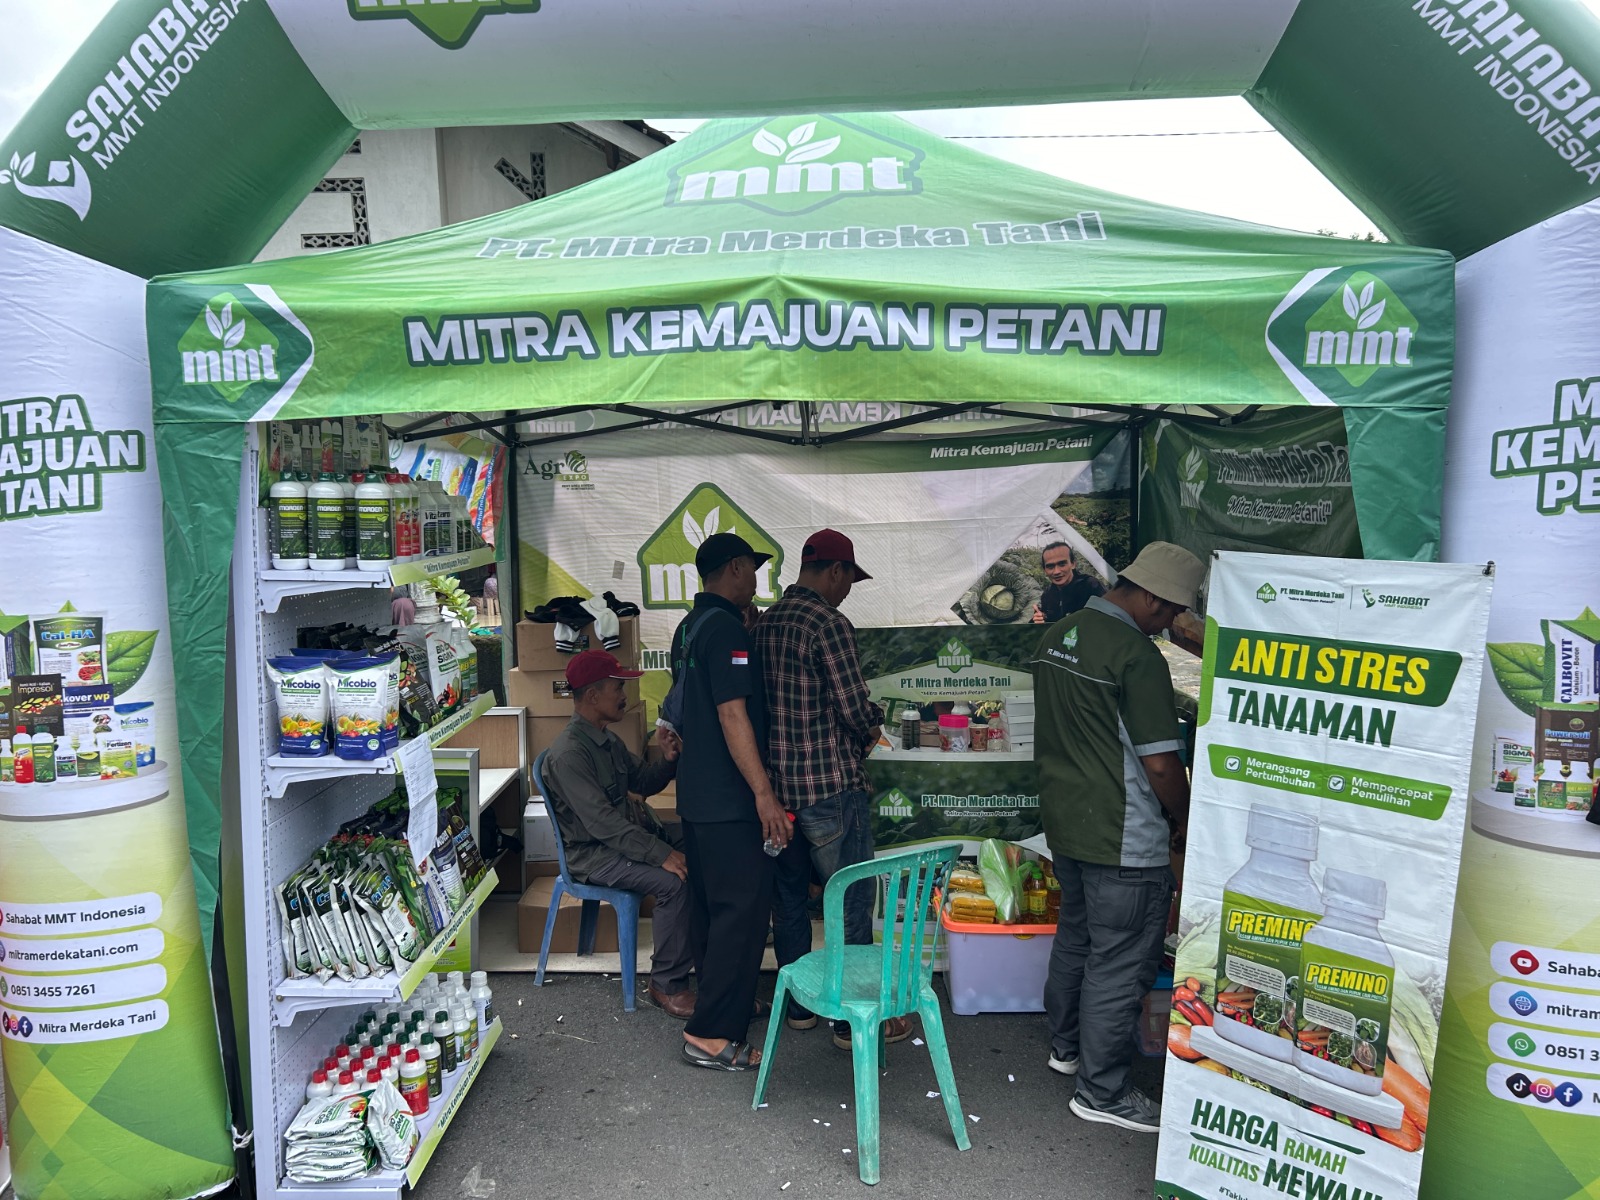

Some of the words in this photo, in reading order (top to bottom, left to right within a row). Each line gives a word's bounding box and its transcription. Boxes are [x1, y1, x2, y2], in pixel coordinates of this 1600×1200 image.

[1444, 0, 1600, 153] AHABA
[1411, 0, 1483, 55] MMT
[1473, 54, 1600, 185] INDONESIA
[91, 105, 145, 170] MMT
[680, 157, 906, 201] mmt
[476, 237, 555, 259] PT.
[561, 236, 710, 259] Mitra
[718, 225, 969, 254] Merdeka
[973, 211, 1108, 246] Tani
[405, 313, 598, 363] MITRA
[610, 303, 931, 353] KEMAJUAN
[948, 307, 1163, 351] PETANI
[1305, 327, 1413, 365] mmt
[183, 344, 279, 383] mmt
[0, 399, 86, 438] TRA
[930, 445, 968, 459] Mitra
[971, 441, 1044, 457] Kemajuan
[1046, 434, 1093, 451] Petani
[1495, 425, 1600, 471] KEM
[1249, 499, 1293, 524] Kemajuan
[650, 562, 774, 602] mt
[1289, 588, 1304, 596] Mitra
[1305, 589, 1330, 598] Merdeka
[1378, 594, 1430, 606] SAHABAT
[41, 629, 95, 641] Cal-HA
[938, 654, 971, 667] mmt
[1229, 637, 1310, 681] ANTI
[1314, 646, 1430, 696] STRES
[1560, 638, 1573, 704] CALBOVIT
[18, 685, 53, 695] Impresol
[281, 678, 320, 689] Micobio
[338, 678, 377, 688] Micobio
[901, 678, 913, 689] PT.
[915, 677, 941, 688] Mitra
[944, 676, 987, 688] Merdeka
[990, 675, 1011, 687] Tani
[61, 694, 92, 703] kover
[94, 693, 110, 703] wp
[121, 717, 148, 726] Micobio
[1227, 687, 1396, 748] TANAMAN
[1503, 749, 1531, 757] SIGMA
[1245, 767, 1316, 789] Pertumbuhan
[1246, 756, 1310, 778] Merangsang
[1350, 786, 1411, 807] Pemulihan
[1351, 776, 1434, 801] Mempercepat
[879, 804, 913, 818] mmt
[921, 794, 937, 808] PT.
[938, 794, 967, 808] Mitra
[968, 794, 1016, 808] Merdeka
[6, 912, 42, 925] Sahabat
[45, 912, 77, 924] MMT
[80, 905, 146, 922] Indonesia
[8, 943, 139, 961] mitramerdekatani.com
[11, 985, 31, 996] 0851
[34, 985, 62, 997] 3455
[65, 984, 96, 996] 7261
[1306, 965, 1387, 995] PREMINO
[39, 1021, 67, 1033] Mitra
[70, 1017, 125, 1032] Merdeka
[128, 1010, 156, 1025] Tani
[1546, 1004, 1600, 1020] mitram
[1545, 1044, 1585, 1060] 0851
[1590, 1050, 1600, 1062] 3
[1190, 1098, 1279, 1152] HARGA
[1283, 1137, 1348, 1175] RAMAH
[1188, 1143, 1260, 1182] KUALITAS
